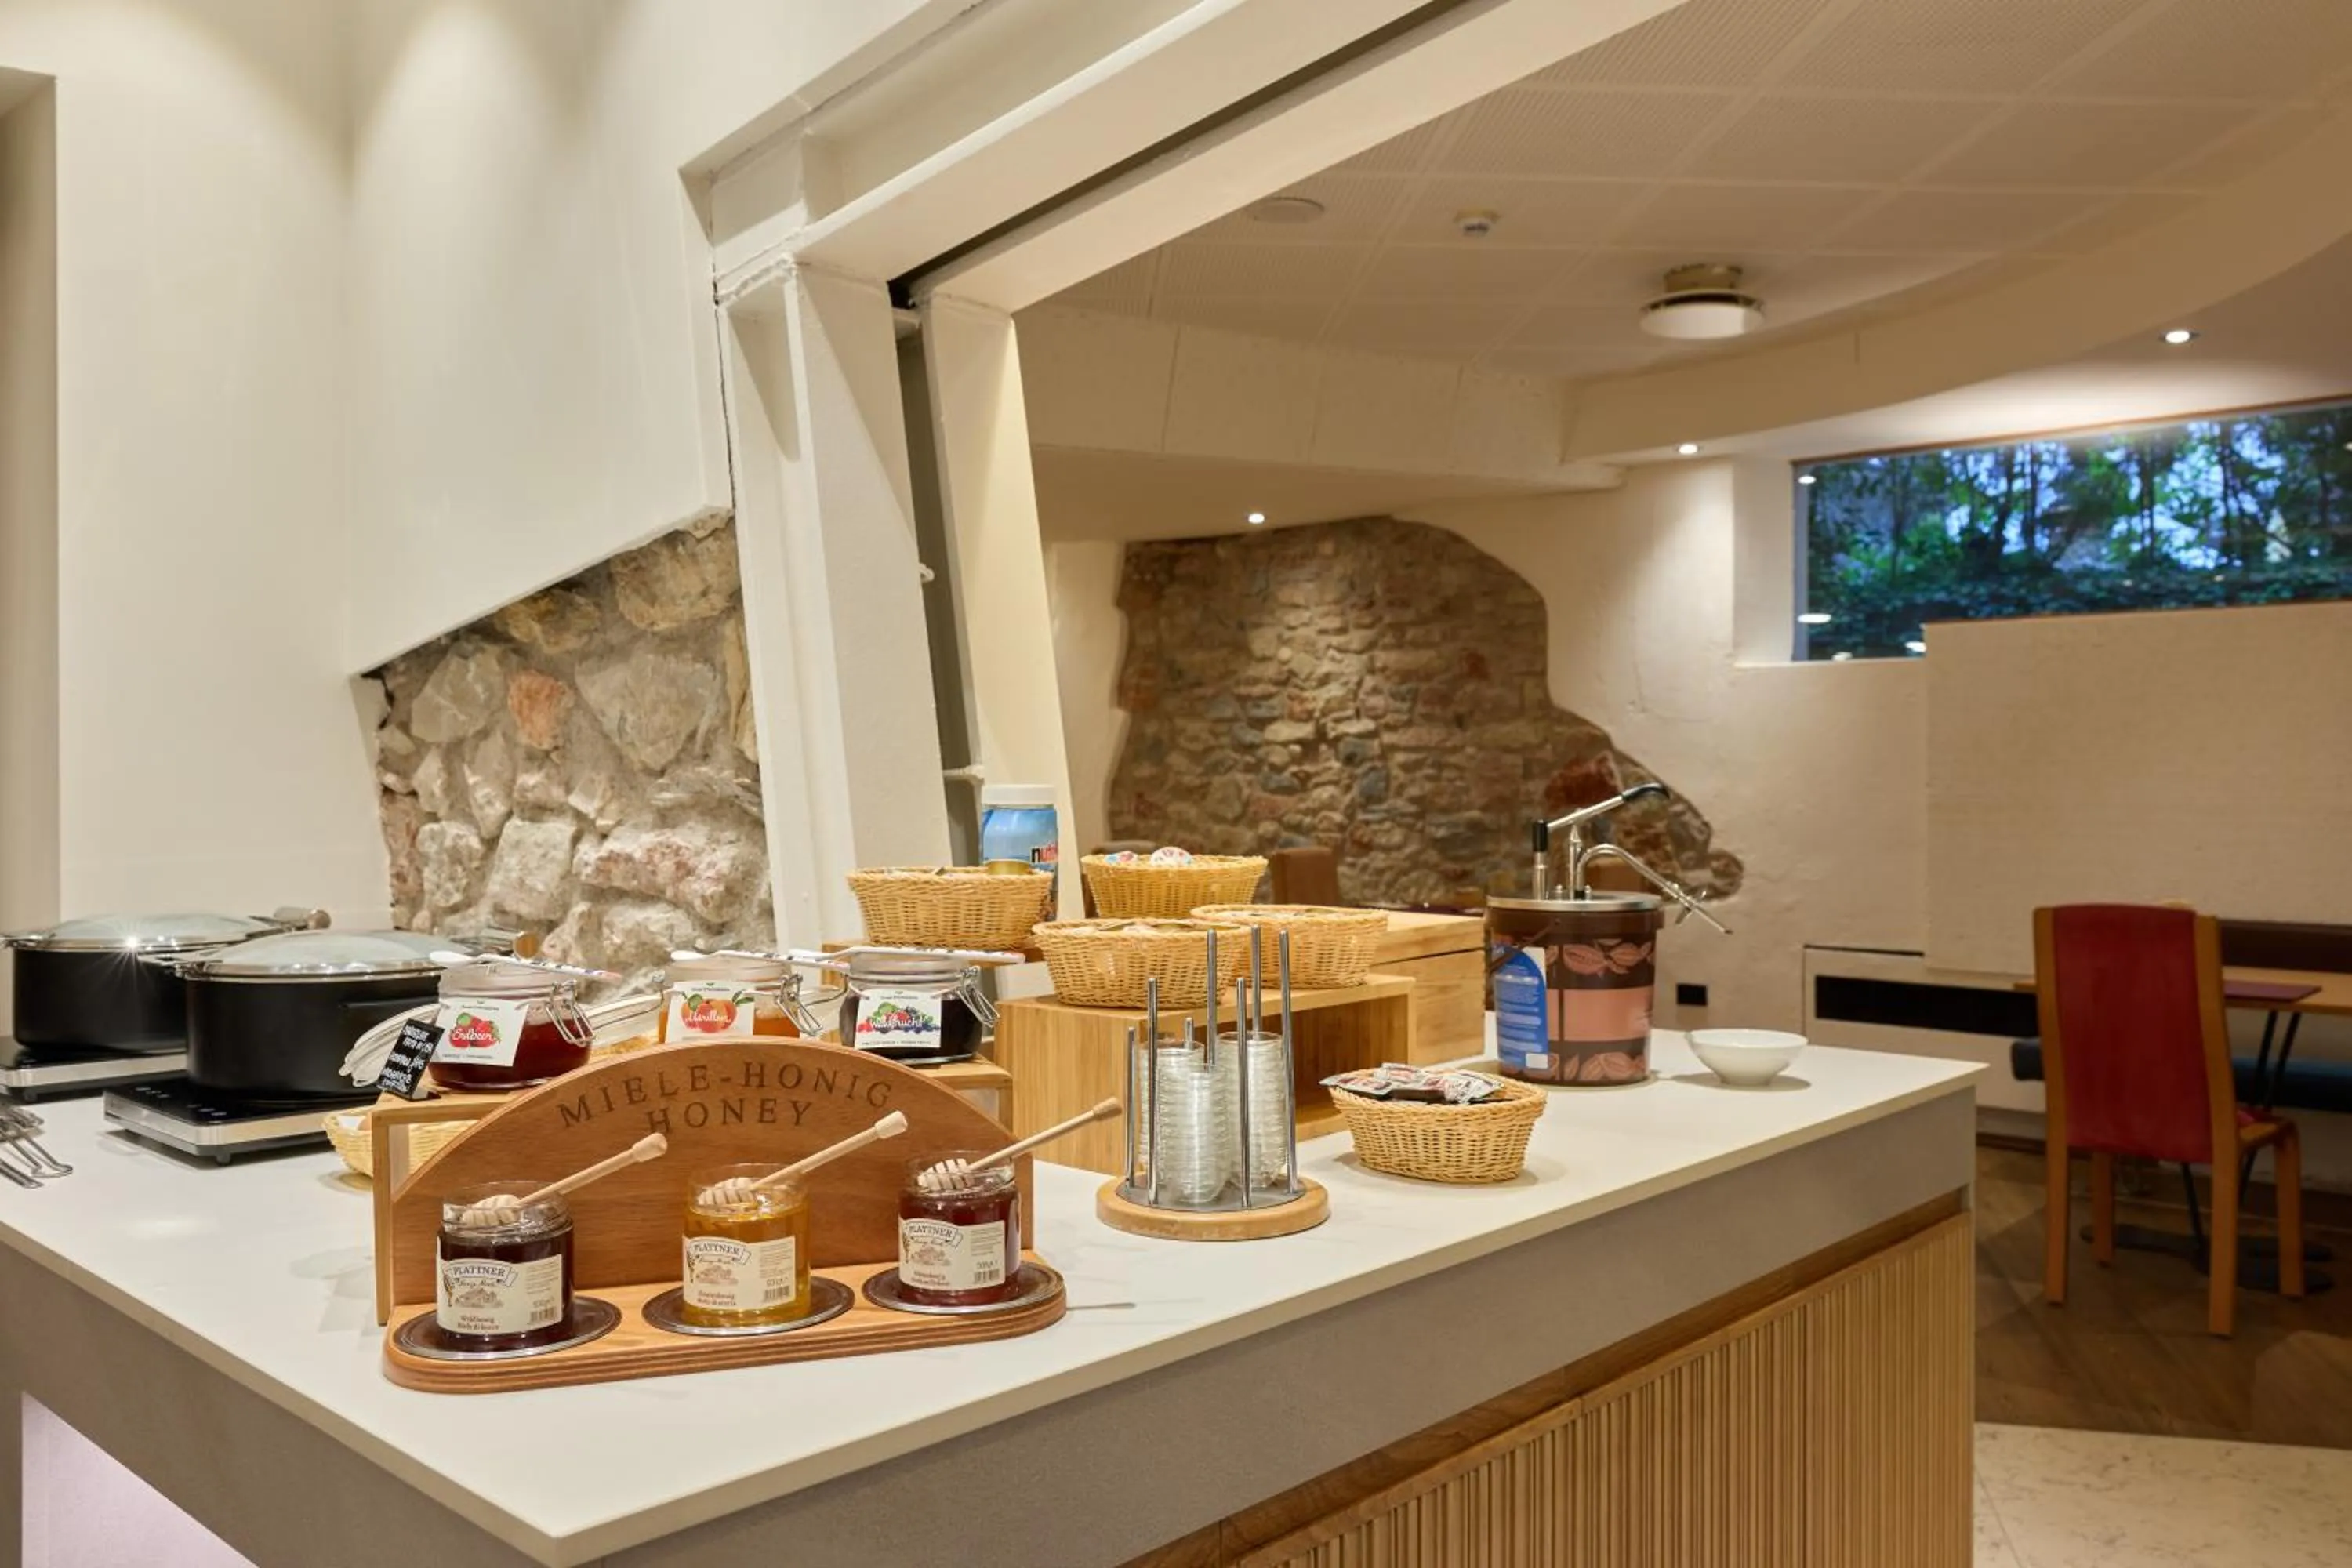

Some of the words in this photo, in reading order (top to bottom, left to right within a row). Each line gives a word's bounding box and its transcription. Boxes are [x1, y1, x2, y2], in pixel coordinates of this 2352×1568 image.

[557, 1062, 892, 1127] MIELE-HONIG
[647, 1098, 813, 1133] HONEY
[909, 1225, 953, 1237] PLATTNER
[693, 1242, 740, 1255] PLATTNER
[453, 1265, 506, 1277] PLATTNER
